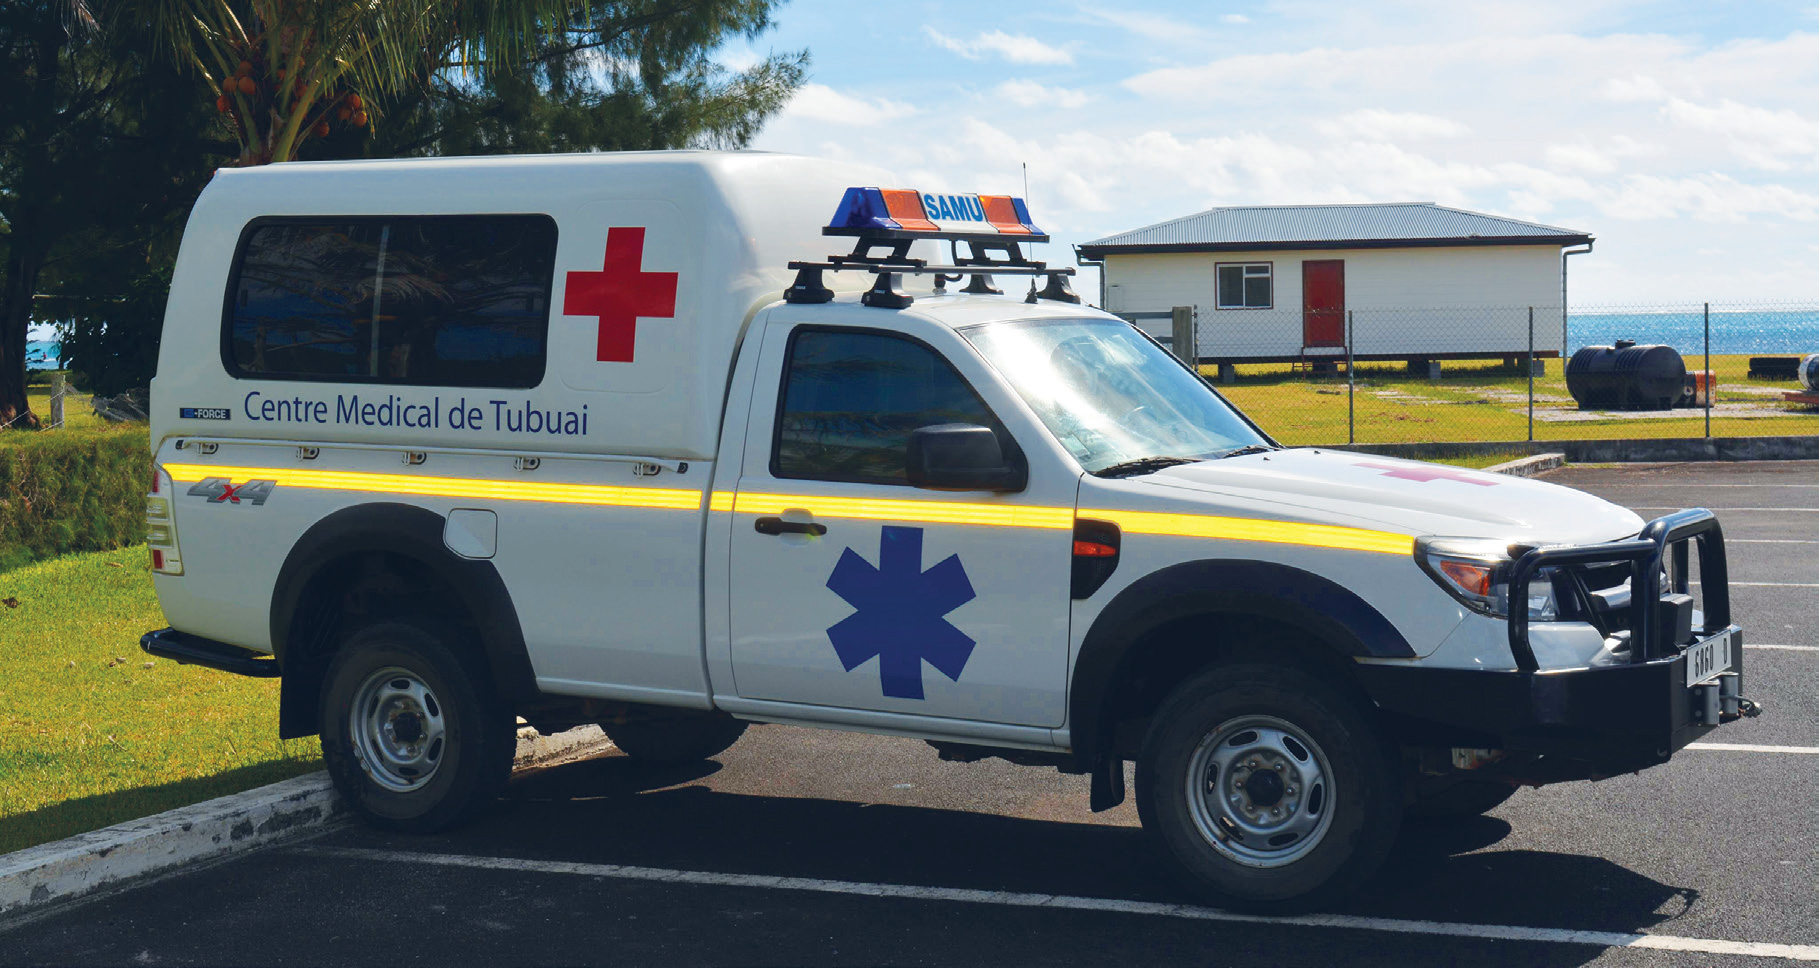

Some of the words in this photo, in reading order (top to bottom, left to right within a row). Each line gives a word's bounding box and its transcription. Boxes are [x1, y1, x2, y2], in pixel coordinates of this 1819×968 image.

[923, 193, 984, 222] SAMU
[244, 391, 328, 424] Centre
[336, 394, 439, 429] Medical
[448, 397, 483, 430] de
[489, 400, 588, 435] Tubuai
